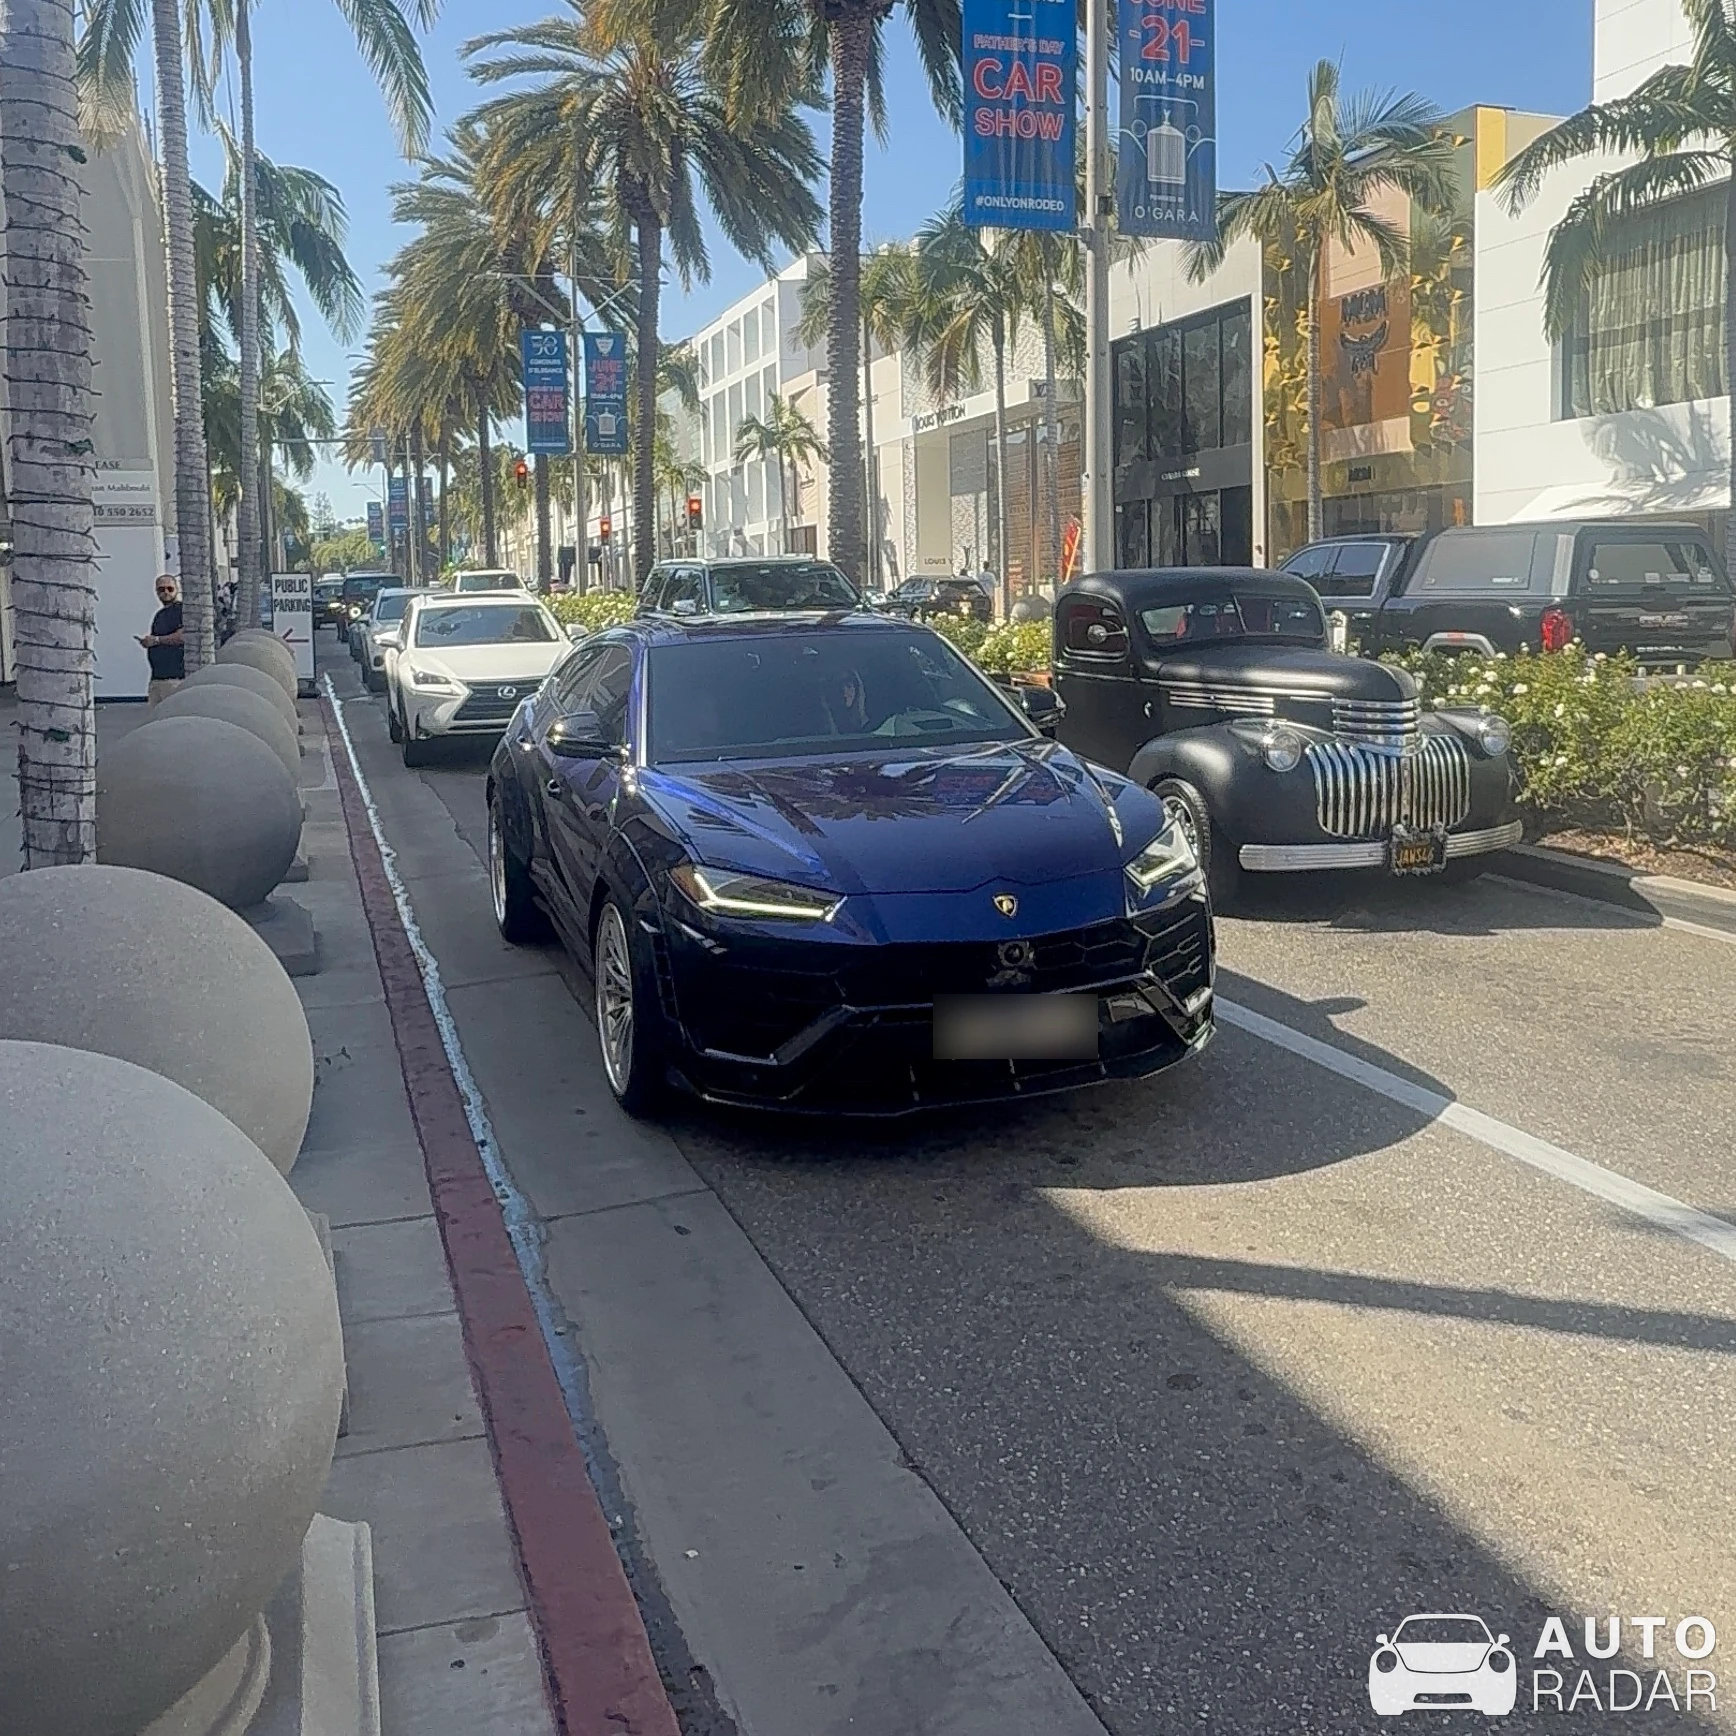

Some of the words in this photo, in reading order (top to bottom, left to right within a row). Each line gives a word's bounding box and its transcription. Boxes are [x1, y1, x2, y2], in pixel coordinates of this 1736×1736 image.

[973, 33, 1036, 53] FATHER'S
[1039, 39, 1065, 55] DAY
[973, 58, 1066, 104] CAR
[974, 107, 1065, 141] SHOW
[975, 195, 1065, 212] #ONLYONRODEO
[1134, 205, 1200, 223] O'GARA
[589, 359, 623, 373] JUNE
[528, 392, 565, 410] CAR
[95, 460, 120, 470] EASE
[107, 507, 126, 517] 550
[128, 507, 154, 517] 2652
[274, 578, 308, 593] PUBLIC
[273, 598, 311, 612] PARKING
